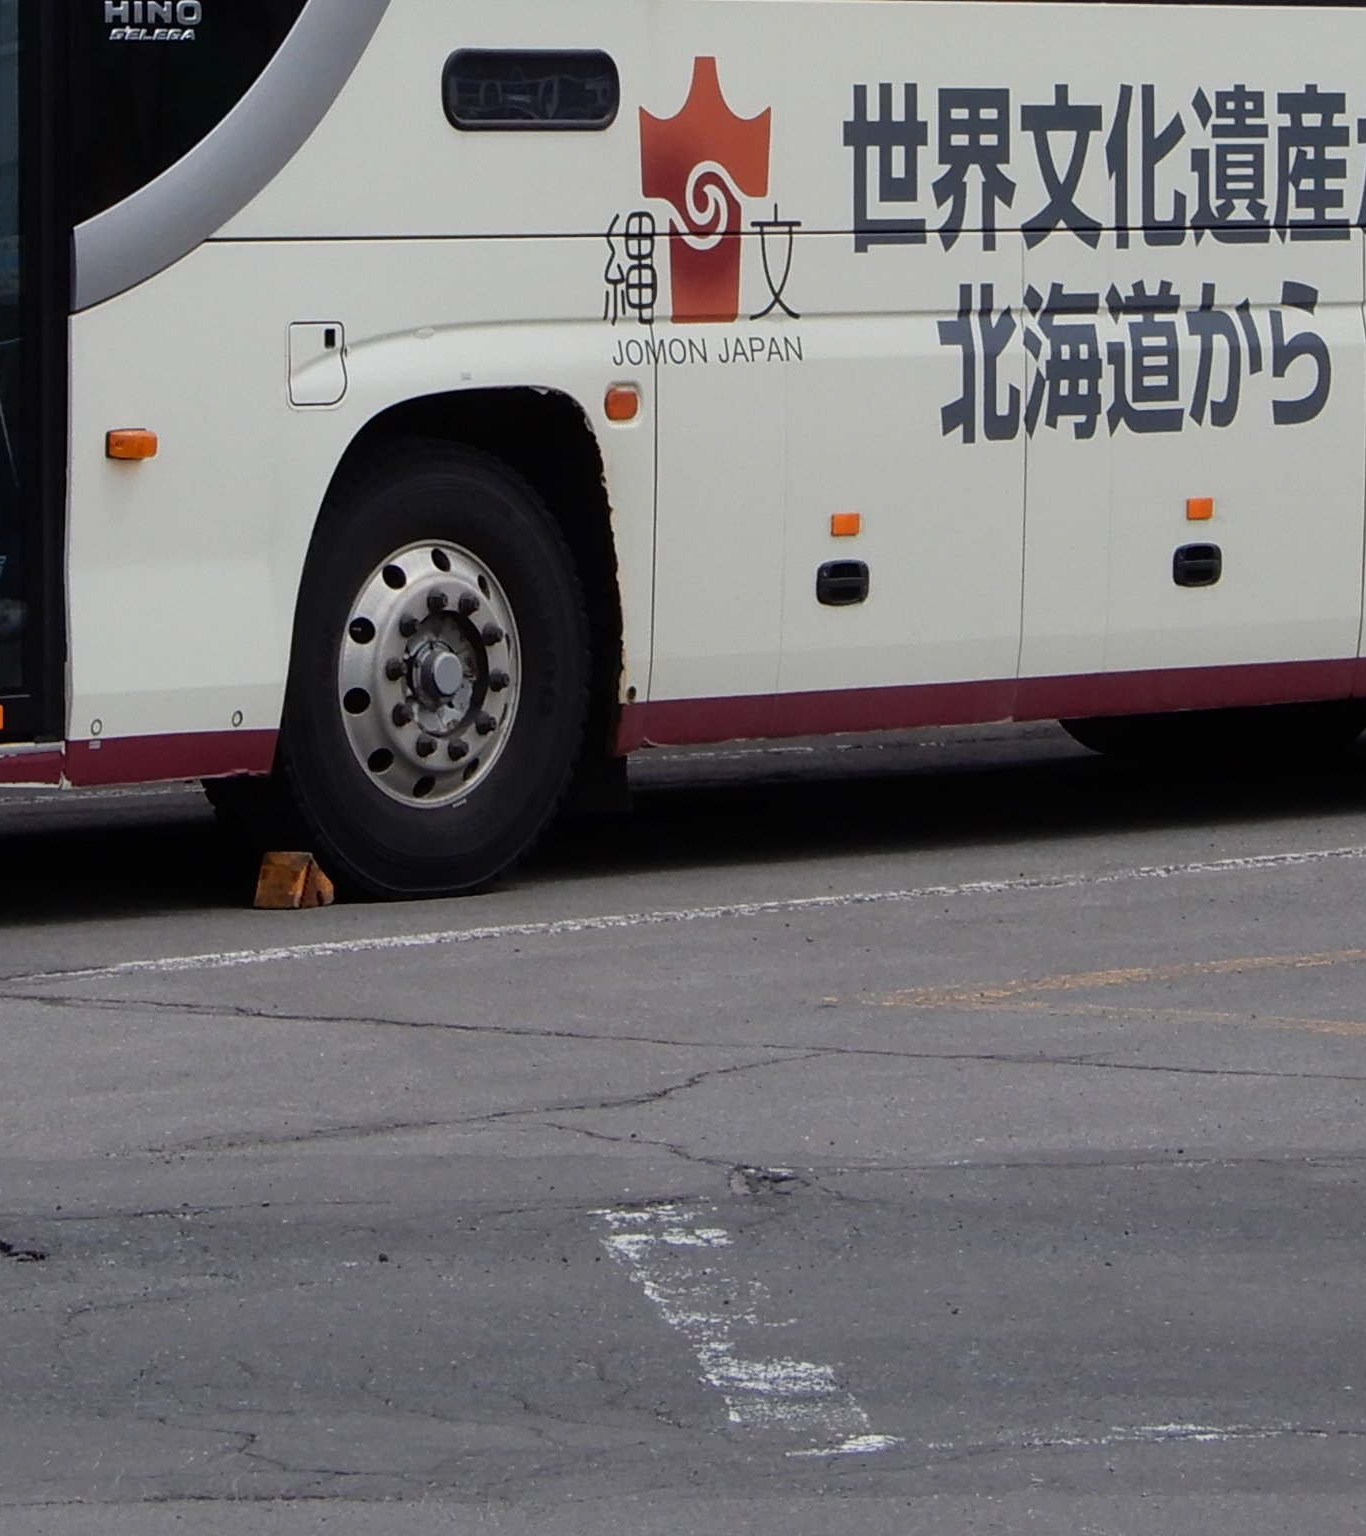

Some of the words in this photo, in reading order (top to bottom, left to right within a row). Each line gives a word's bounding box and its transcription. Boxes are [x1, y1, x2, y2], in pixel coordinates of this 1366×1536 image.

[103, 0, 202, 25] HINO
[612, 337, 708, 367] JOMON
[718, 335, 804, 364] JAPAN
[937, 279, 1332, 445] 北海道から
